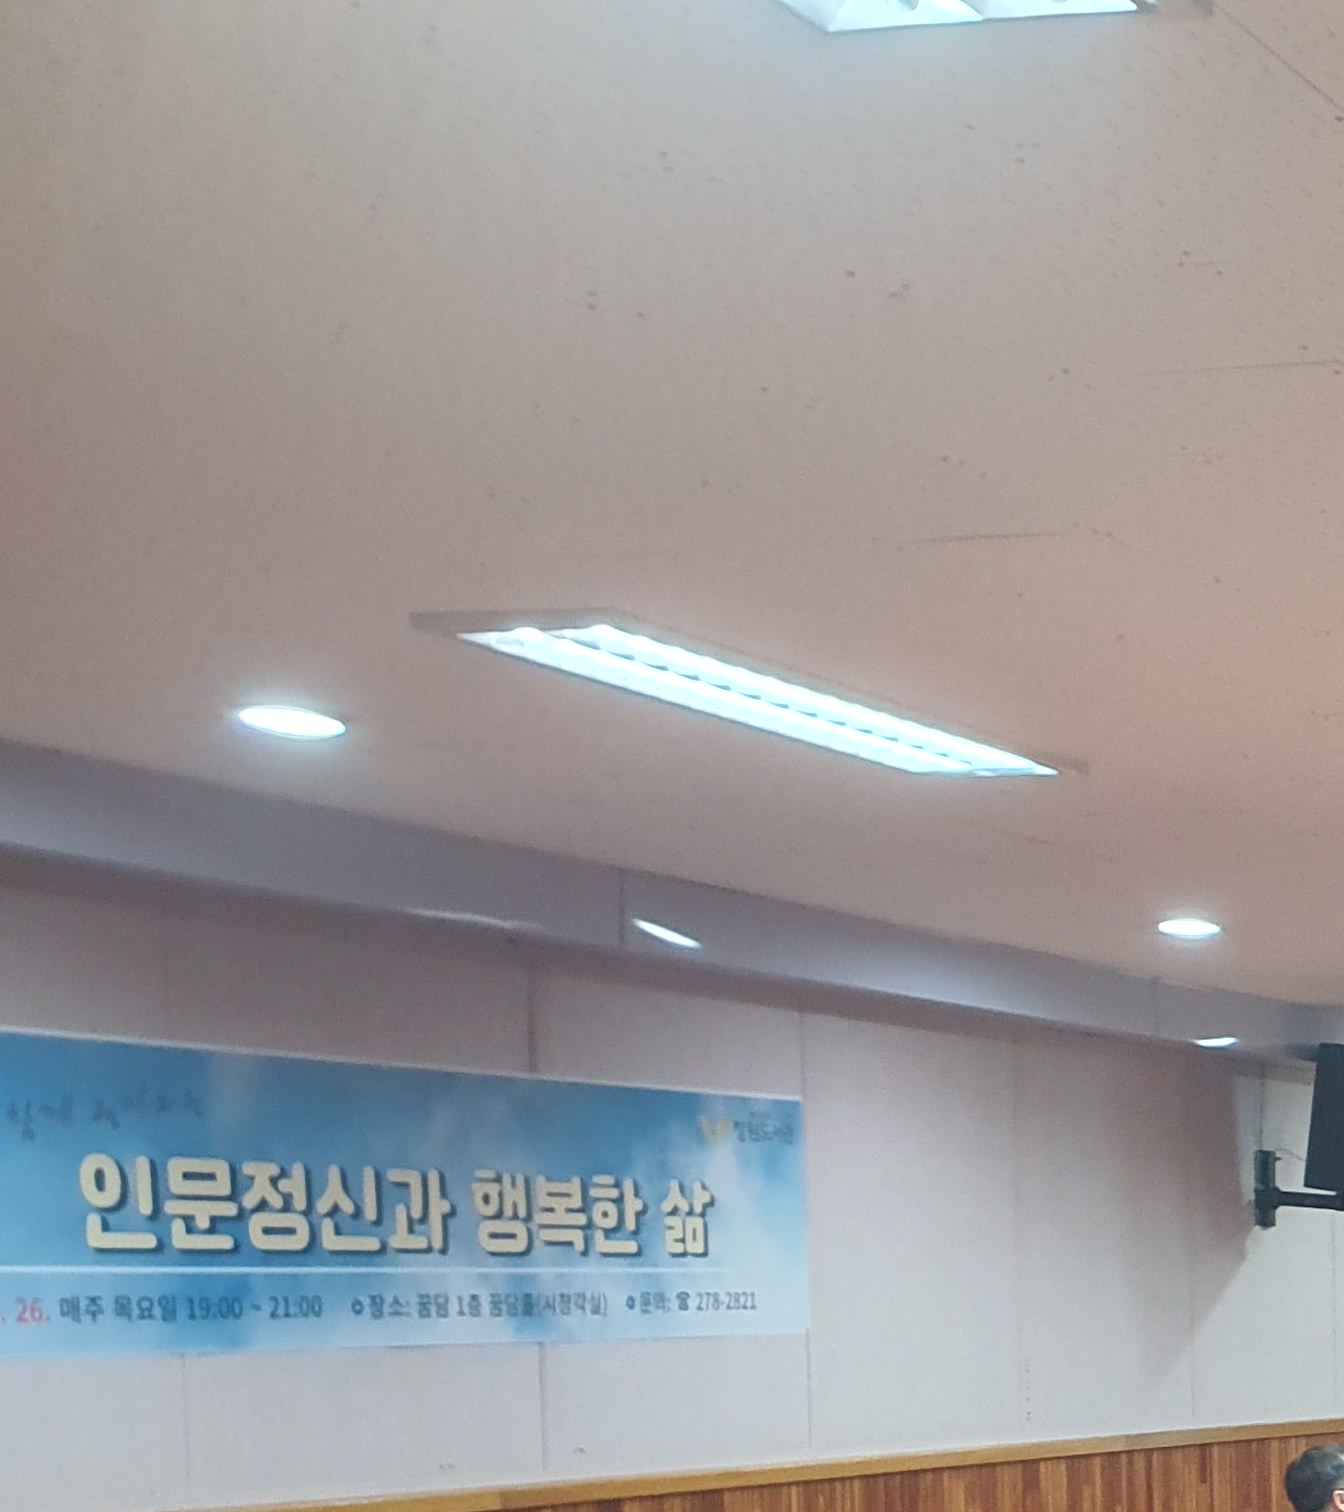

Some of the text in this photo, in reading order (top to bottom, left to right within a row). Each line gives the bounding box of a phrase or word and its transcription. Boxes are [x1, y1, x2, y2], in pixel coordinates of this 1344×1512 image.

[79, 1152, 716, 1258] 인문정신과 행복한 삶
[58, 1295, 105, 1323] 매주
[113, 1294, 178, 1323] 목요일
[186, 1296, 244, 1321] 19:00
[268, 1295, 324, 1320] 21:00
